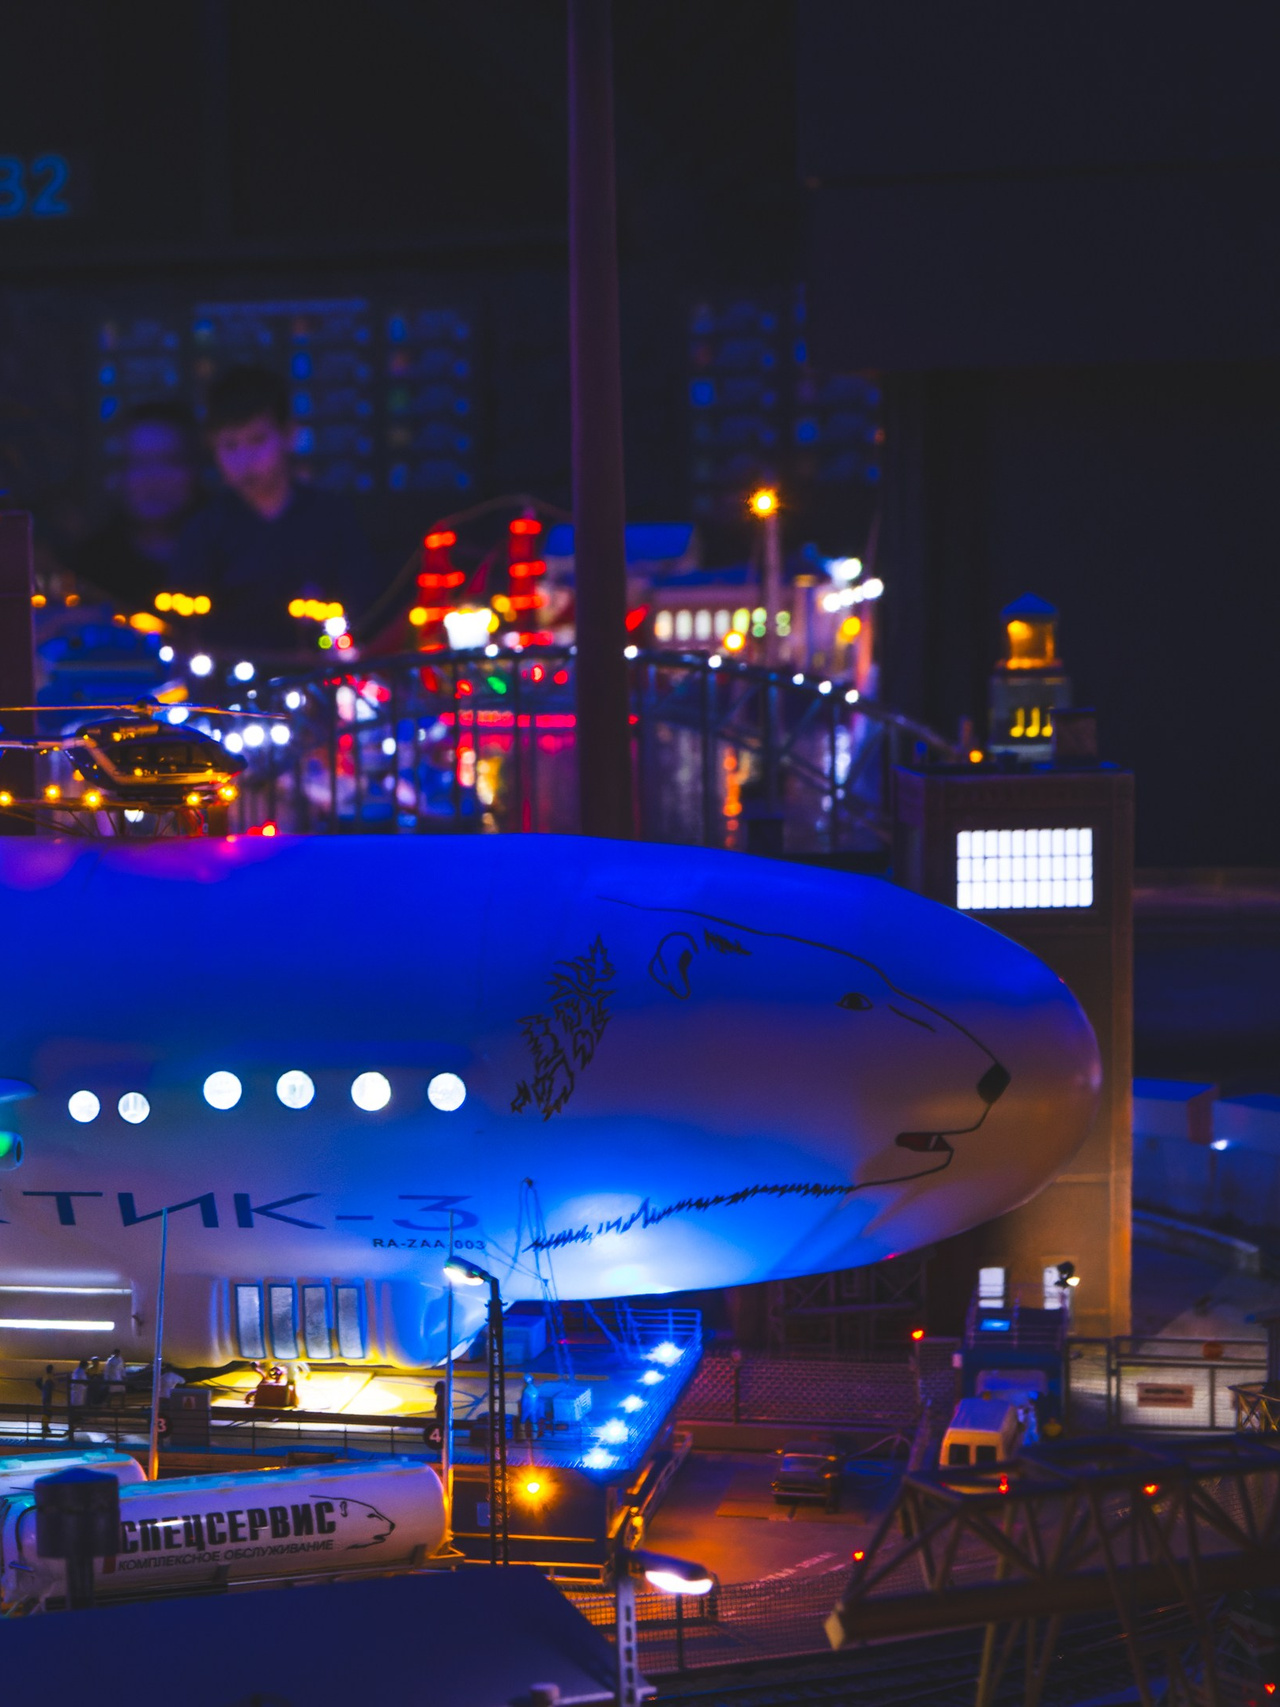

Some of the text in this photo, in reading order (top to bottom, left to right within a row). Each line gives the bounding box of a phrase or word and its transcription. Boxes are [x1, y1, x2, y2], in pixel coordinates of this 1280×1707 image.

[157, 1417, 167, 1433] 3
[429, 1428, 442, 1443] 4
[119, 1501, 337, 1553] СПЕЦСЕРВИС
[118, 1539, 335, 1571] КОМПЛЕКСНОЕ ОБСЛУЖИВАНИЕ
